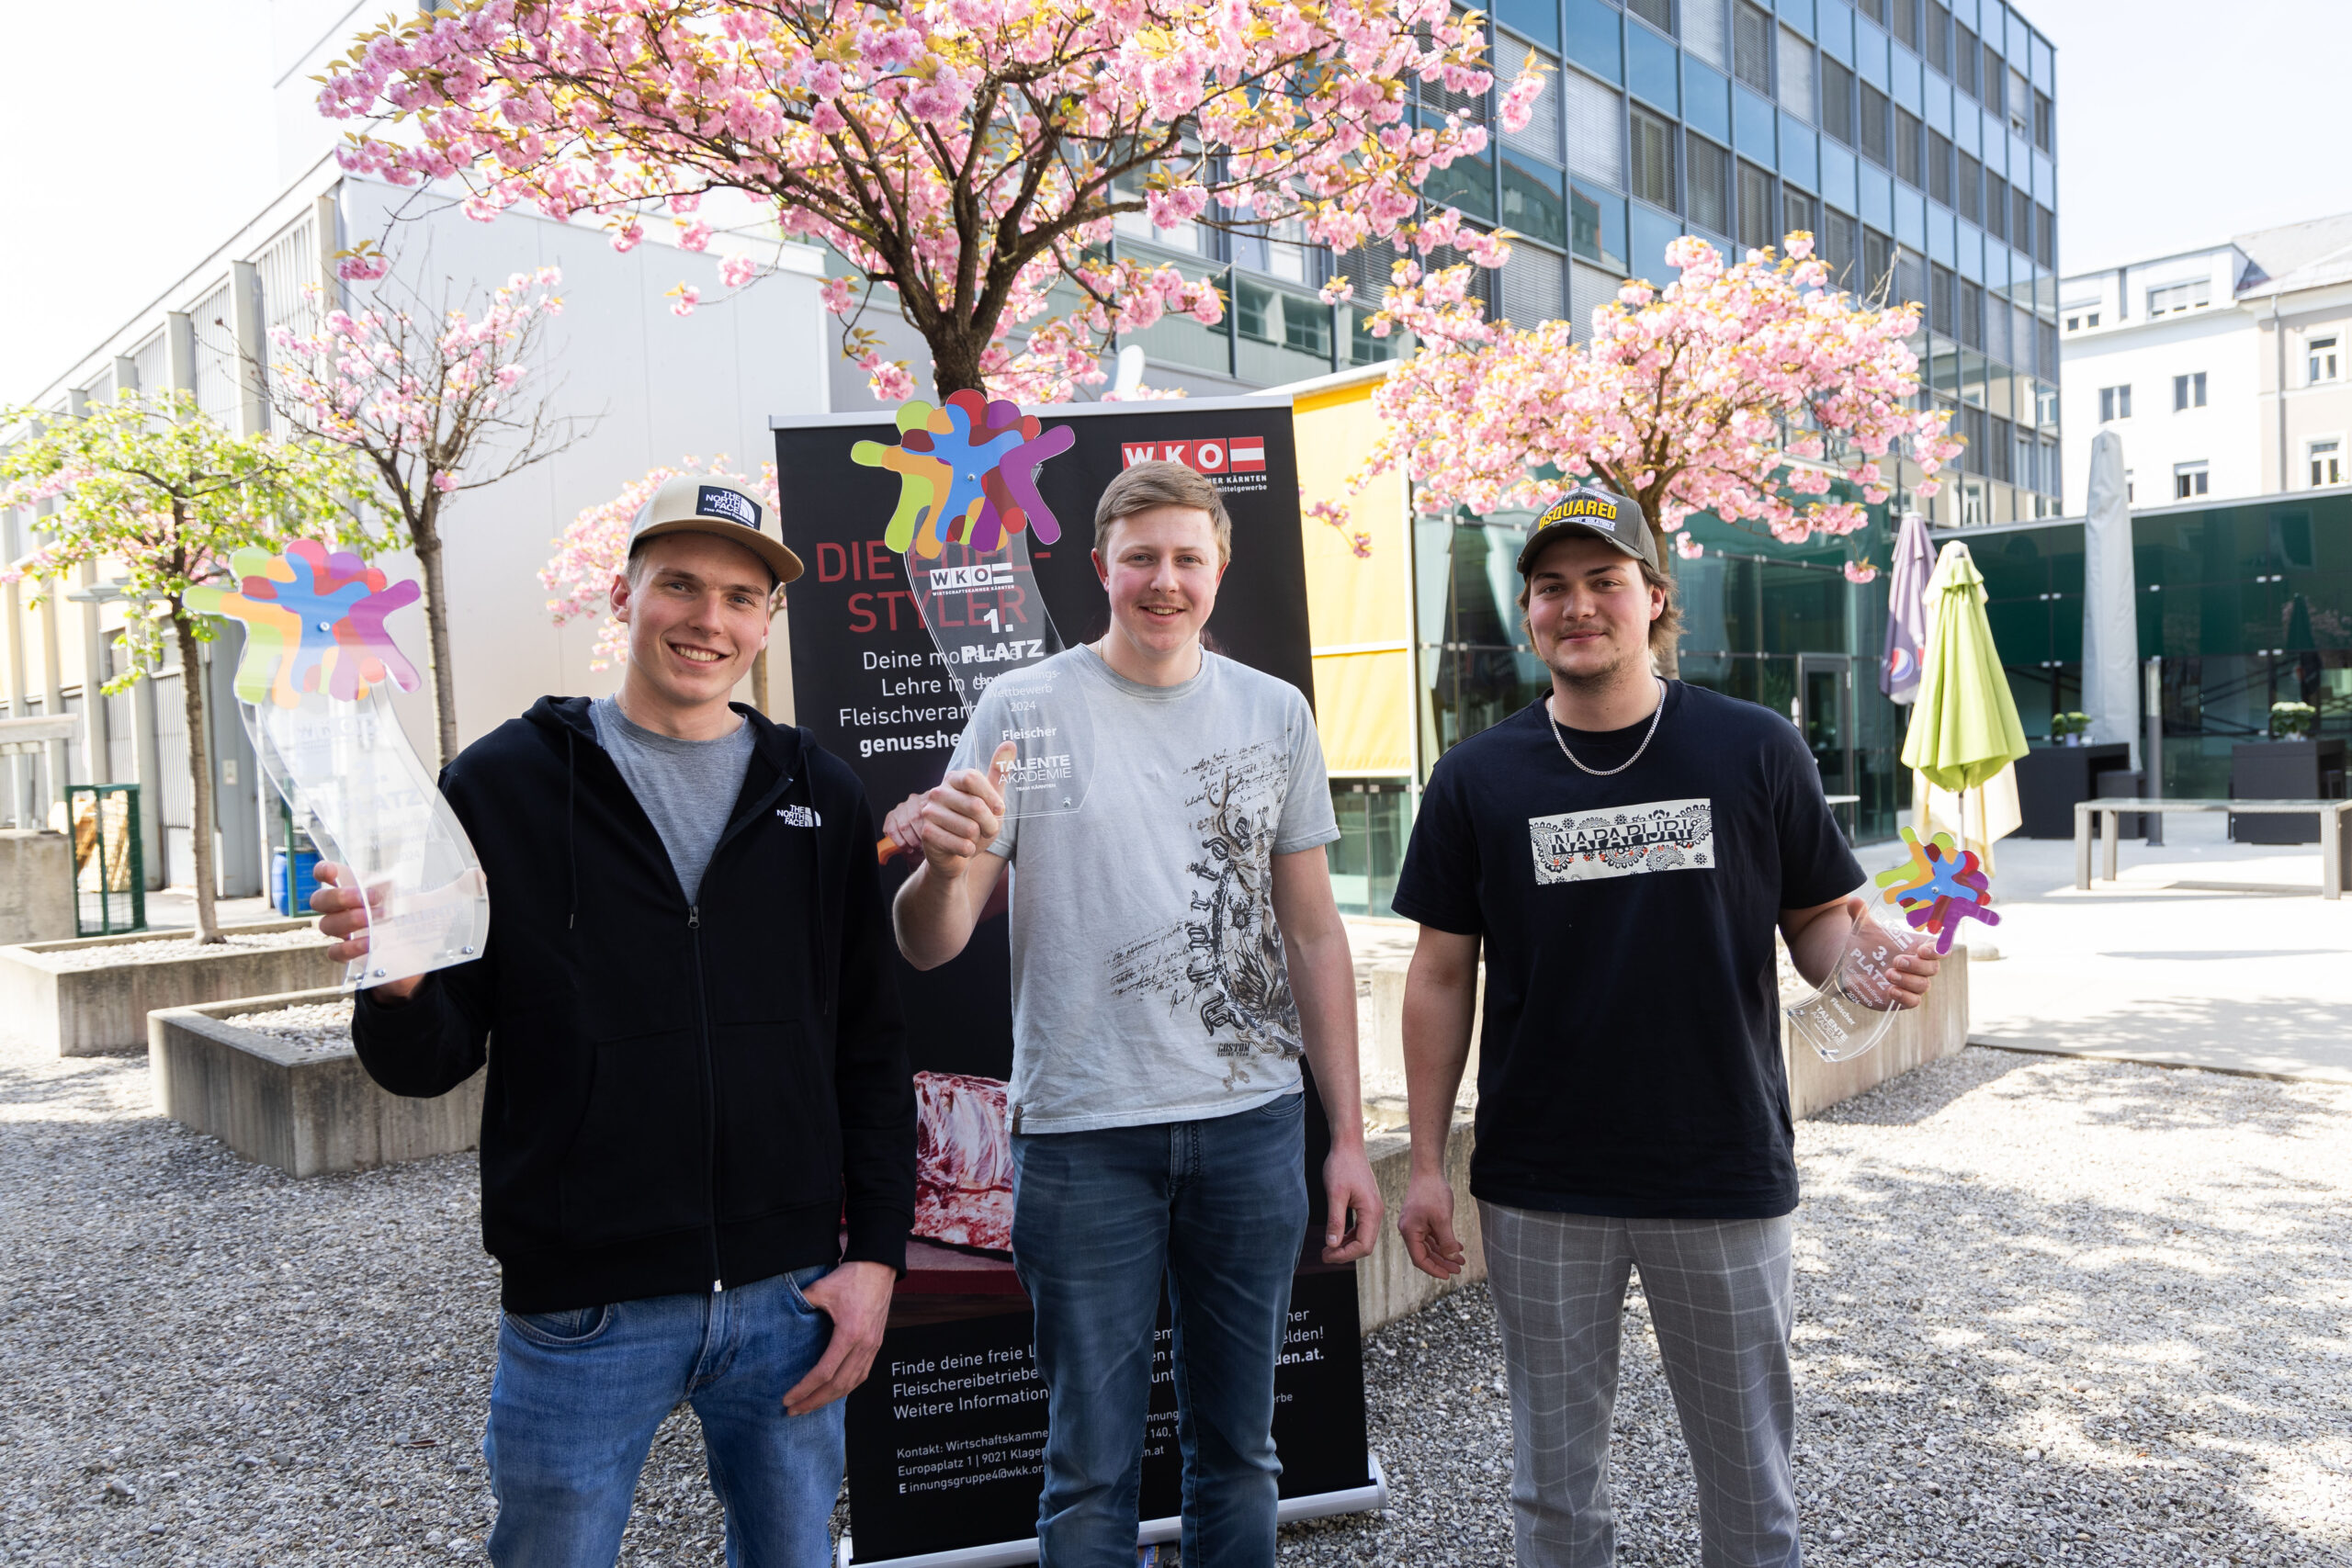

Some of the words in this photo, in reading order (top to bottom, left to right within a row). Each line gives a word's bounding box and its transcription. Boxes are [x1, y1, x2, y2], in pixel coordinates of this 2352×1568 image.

[1227, 474, 1267, 484] KÄRNTEN
[706, 494, 741, 507] NORTH
[722, 491, 741, 501] THE
[714, 501, 740, 514] FACE
[816, 539, 895, 582] DIE
[932, 566, 990, 588] WKO
[847, 583, 1028, 634] STYLER
[983, 608, 1014, 634] 1.
[863, 650, 922, 671] Deine
[961, 639, 1045, 664] PLATZ
[881, 677, 941, 697] Lehre
[989, 683, 1053, 698] Wettbewerb
[1010, 700, 1036, 712] 2024
[1001, 726, 1057, 740] Fleischer
[996, 754, 1071, 773] TALENTE
[998, 767, 1072, 785] AKADEMIE
[776, 809, 805, 820] NORTH
[790, 804, 805, 814] THE
[785, 817, 805, 827] FACE
[1871, 945, 1887, 967] 3.
[1849, 947, 1891, 990] PLATZ
[1829, 997, 1856, 1025] Fleischer
[1815, 1005, 1849, 1043] TALENTE
[891, 1359, 935, 1377] Finde
[940, 1352, 983, 1371] deine
[988, 1348, 1023, 1364] freie
[892, 1367, 1038, 1398] Fleischereibetriebe
[893, 1401, 954, 1420] Weitere
[959, 1387, 1050, 1412] Information
[897, 1444, 944, 1460] Kontakt:
[898, 1460, 964, 1477] Europaplatz
[967, 1456, 972, 1466] 1
[981, 1450, 1007, 1464] 9021
[899, 1483, 907, 1494] E
